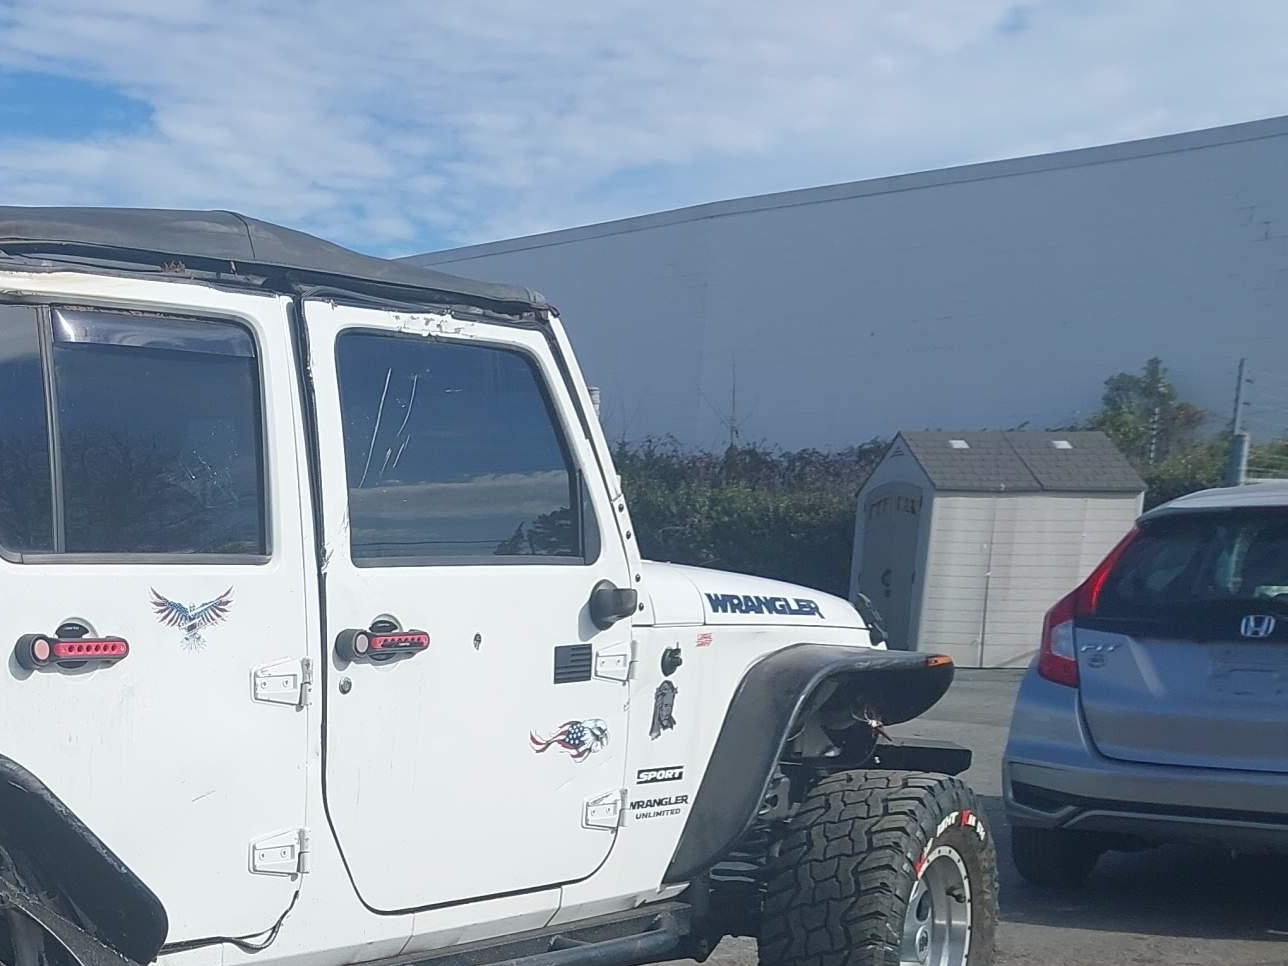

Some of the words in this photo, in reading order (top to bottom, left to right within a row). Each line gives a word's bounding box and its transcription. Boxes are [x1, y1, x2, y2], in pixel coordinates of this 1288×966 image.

[704, 592, 826, 620] WRANGLER
[638, 767, 683, 783] SPORT
[629, 794, 689, 810] WRANGLER
[635, 807, 682, 820] UNLIMITED
